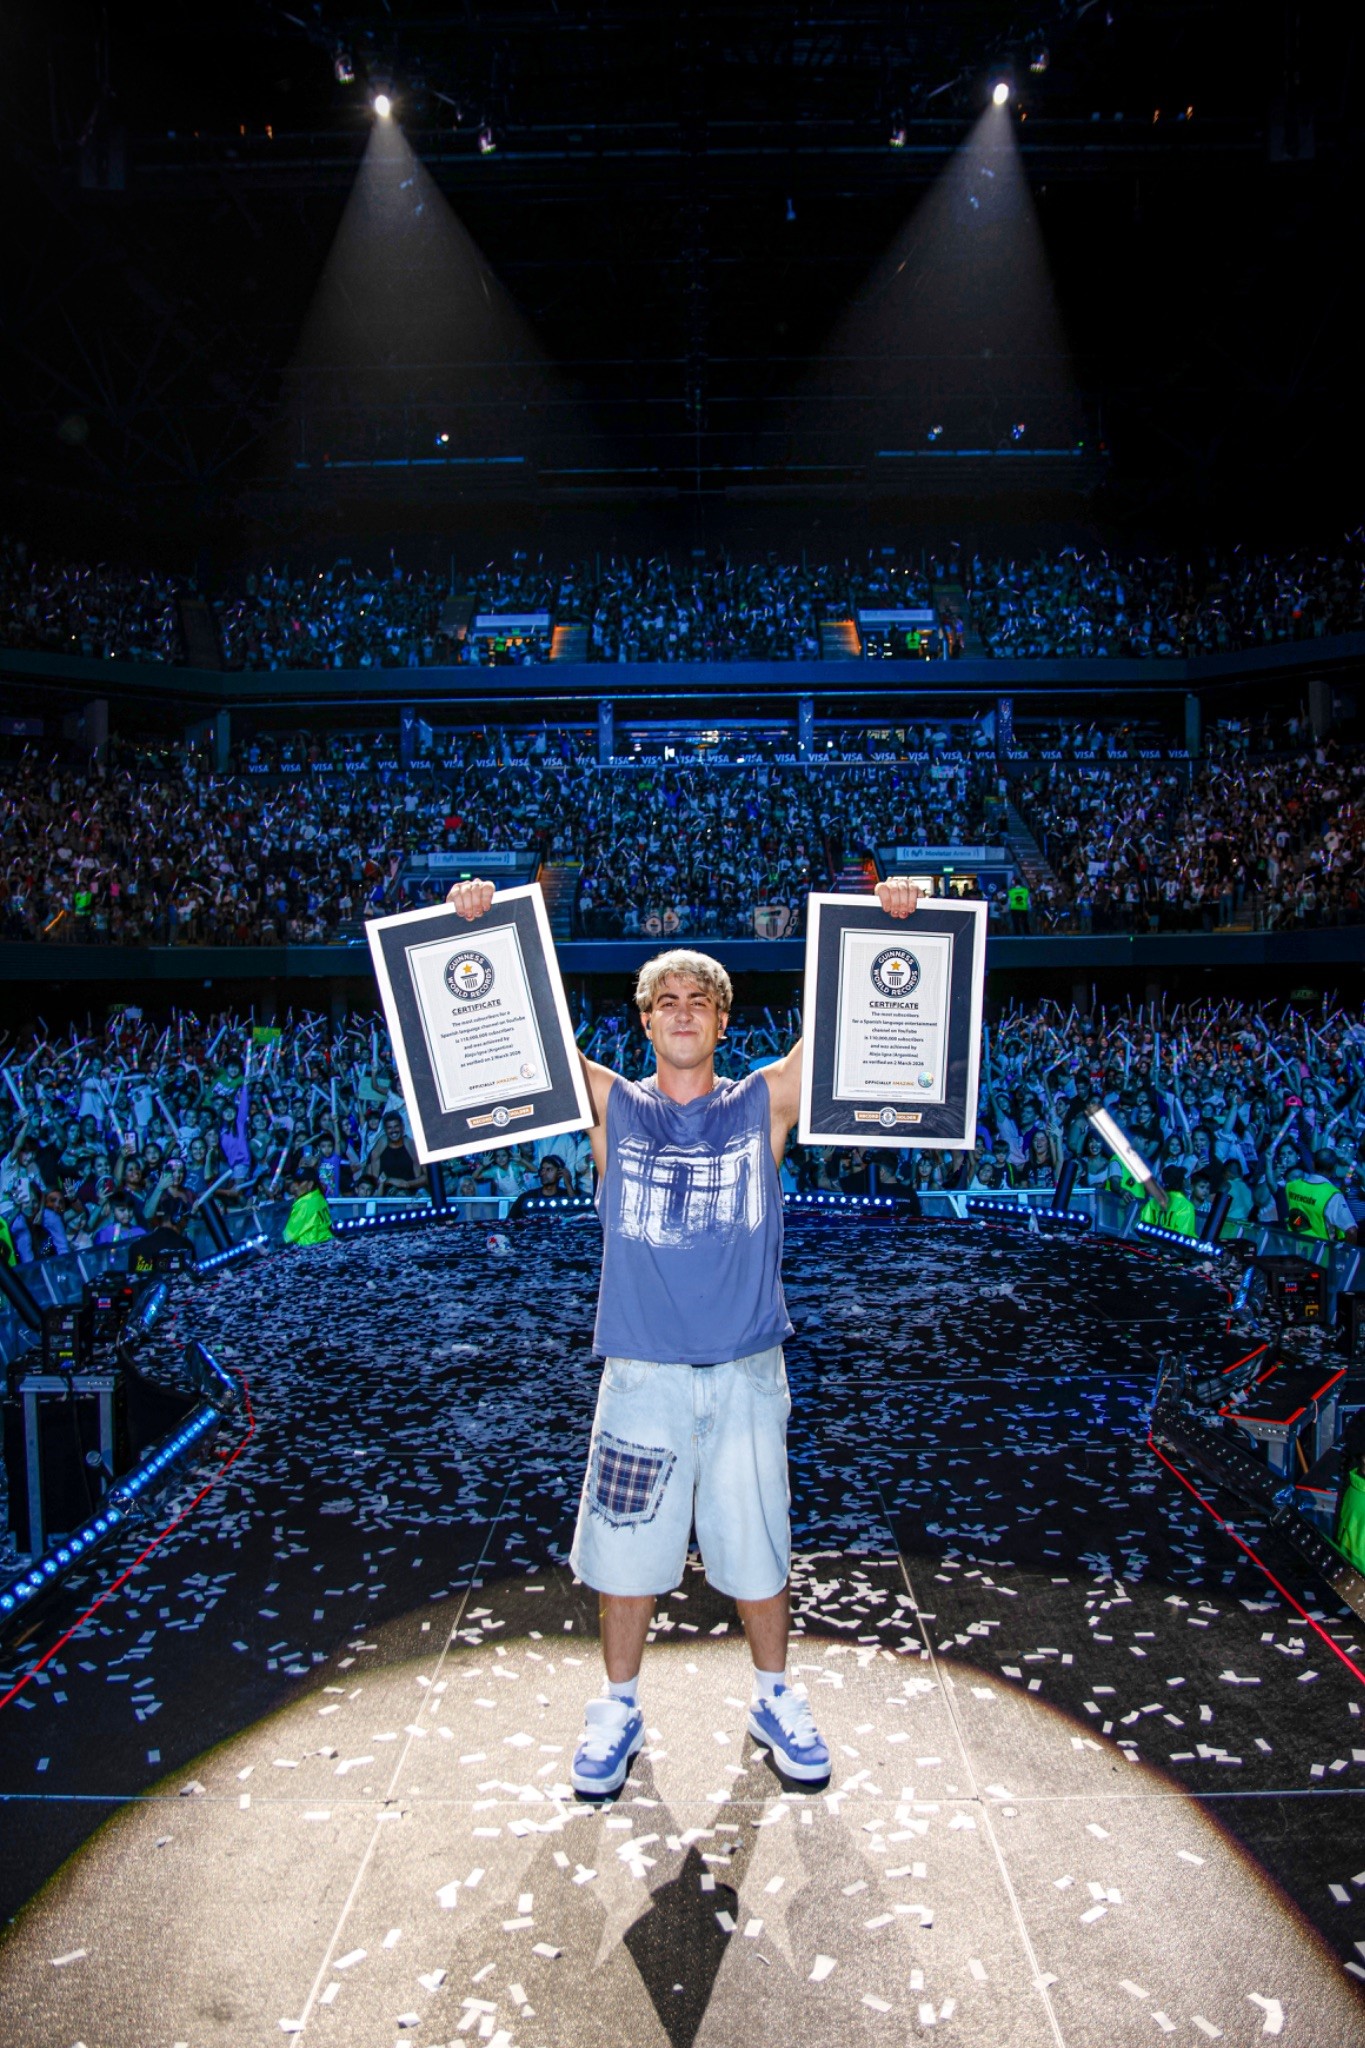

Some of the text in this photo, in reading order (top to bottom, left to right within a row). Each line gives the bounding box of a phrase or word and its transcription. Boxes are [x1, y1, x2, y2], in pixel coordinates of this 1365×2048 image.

[608, 756, 629, 764] VISA
[708, 755, 730, 763] VISA
[742, 754, 762, 762] VISA
[774, 754, 796, 762] VISA
[808, 753, 829, 762] VISA
[842, 752, 863, 761] VISA
[875, 752, 896, 760] VISA
[908, 752, 930, 760] VISA
[941, 752, 962, 760] VISA
[1008, 752, 1029, 760] VISA
[542, 758, 562, 766] VISA
[878, 951, 914, 964] GUINNESS
[449, 954, 484, 970] GUINNESS
[448, 968, 492, 998] WORLD RECORDS
[873, 969, 918, 996] WORLD RECORDS
[452, 999, 502, 1016] CERTIFICATE
[870, 1001, 919, 1010] CERTIFICATE
